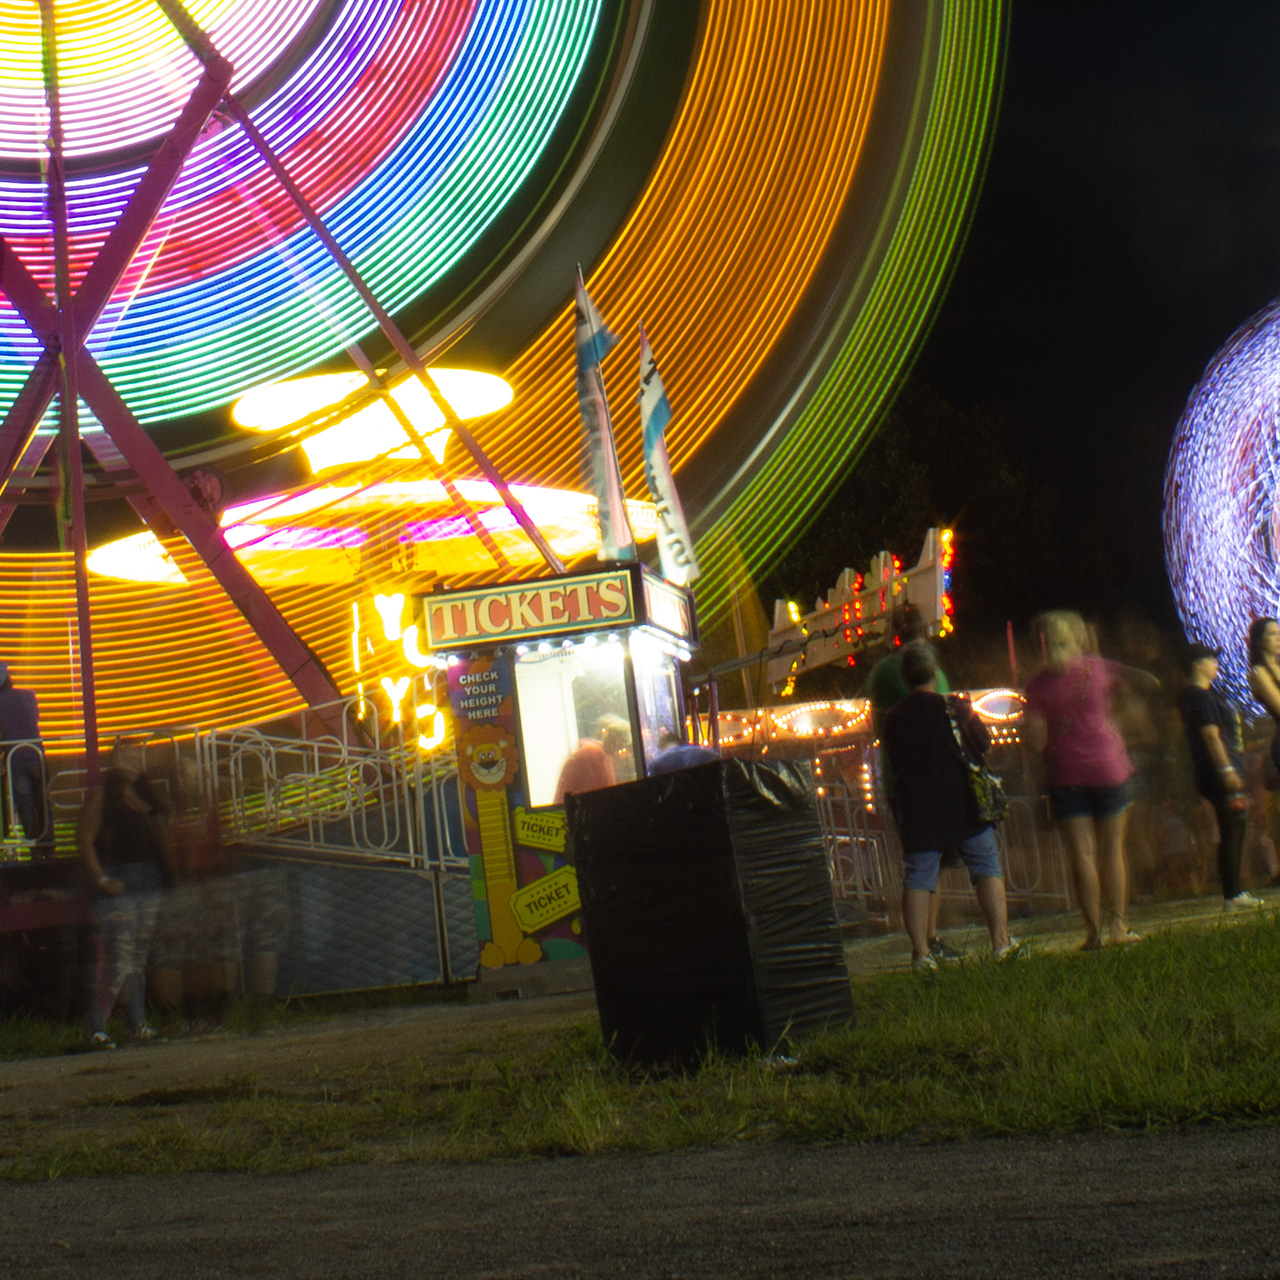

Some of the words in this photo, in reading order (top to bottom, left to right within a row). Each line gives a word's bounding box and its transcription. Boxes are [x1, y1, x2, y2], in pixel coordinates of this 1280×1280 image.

[434, 578, 628, 640] TICKETS
[459, 670, 499, 685] CHECK
[464, 683, 497, 696] YOUR
[460, 694, 503, 709] HEIGHT
[468, 707, 499, 720] HERE
[520, 819, 562, 838] TICKET
[525, 882, 572, 915] TICKET
